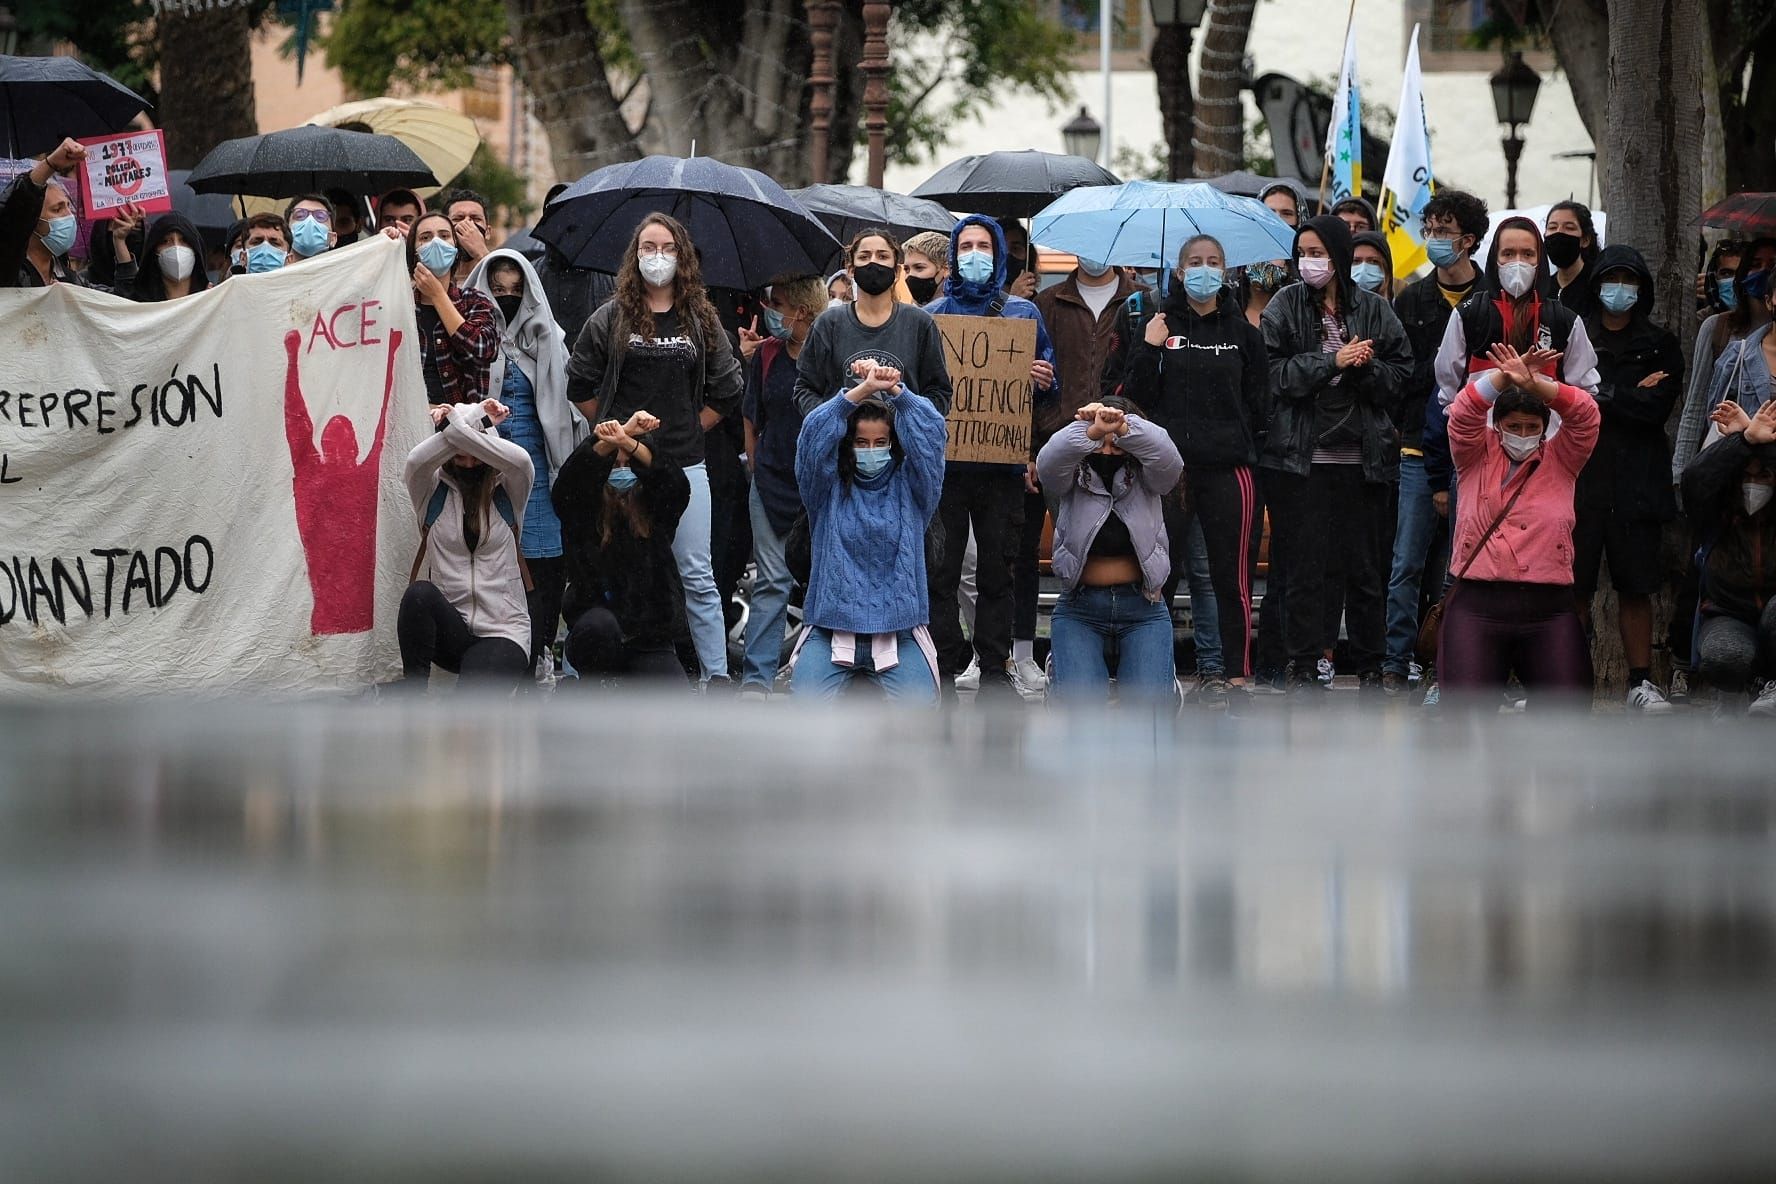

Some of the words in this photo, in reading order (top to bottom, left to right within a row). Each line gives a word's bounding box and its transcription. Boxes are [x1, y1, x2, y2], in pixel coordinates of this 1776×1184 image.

[102, 140, 133, 160] 1977
[104, 167, 151, 187] MILITARES
[105, 159, 137, 175] POLICÍA
[307, 300, 381, 354] ACE
[941, 329, 989, 368] NO
[1165, 335, 1239, 356] Champion
[0, 363, 222, 434] REPRESIÓN
[0, 535, 213, 627] DIANTADO
